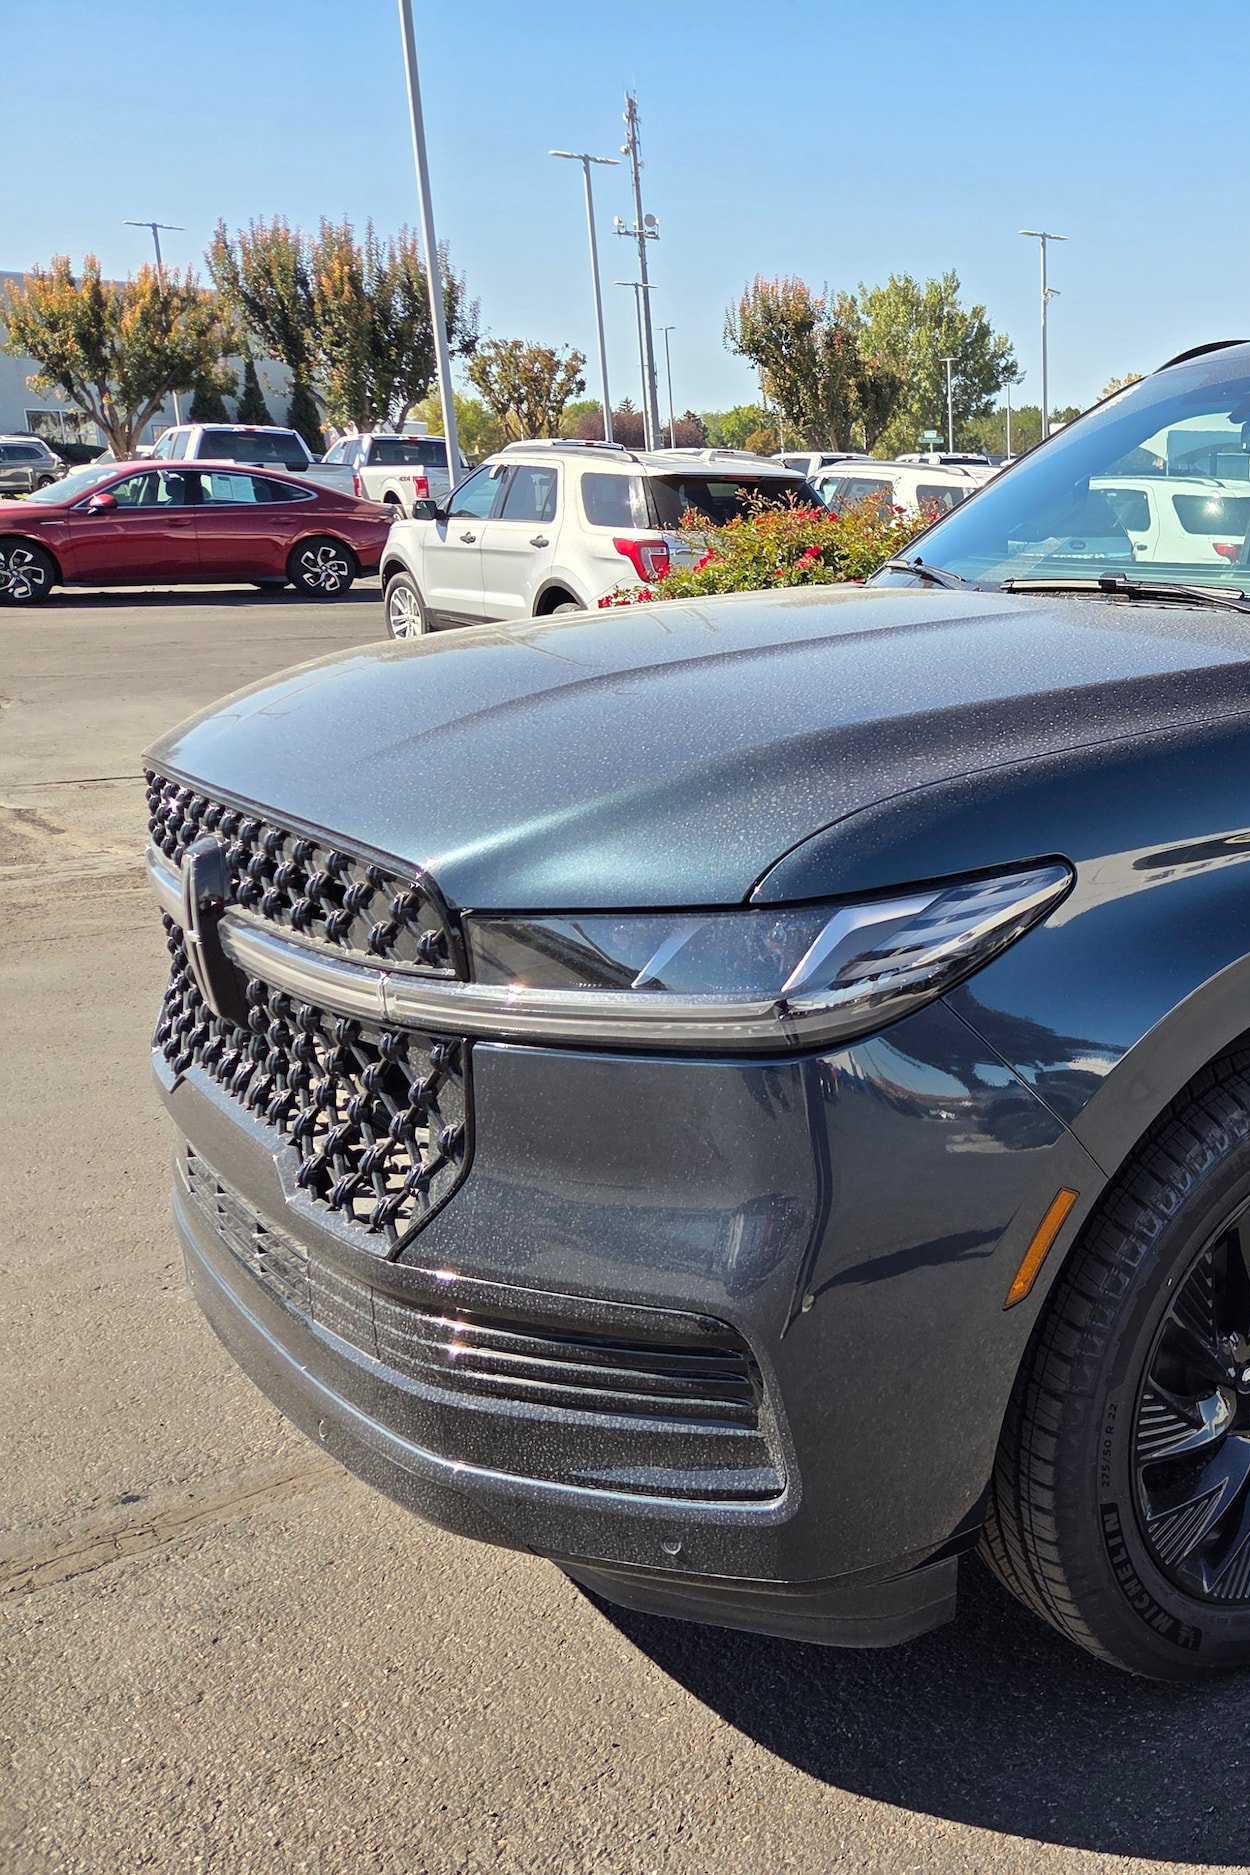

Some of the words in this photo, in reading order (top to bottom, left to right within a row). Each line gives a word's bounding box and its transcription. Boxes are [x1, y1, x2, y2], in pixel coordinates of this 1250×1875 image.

[1108, 1403, 1118, 1421] 22
[1105, 1425, 1114, 1435] R
[1101, 1439, 1112, 1488] 275/50
[1103, 1511, 1175, 1634] MICHELIN
